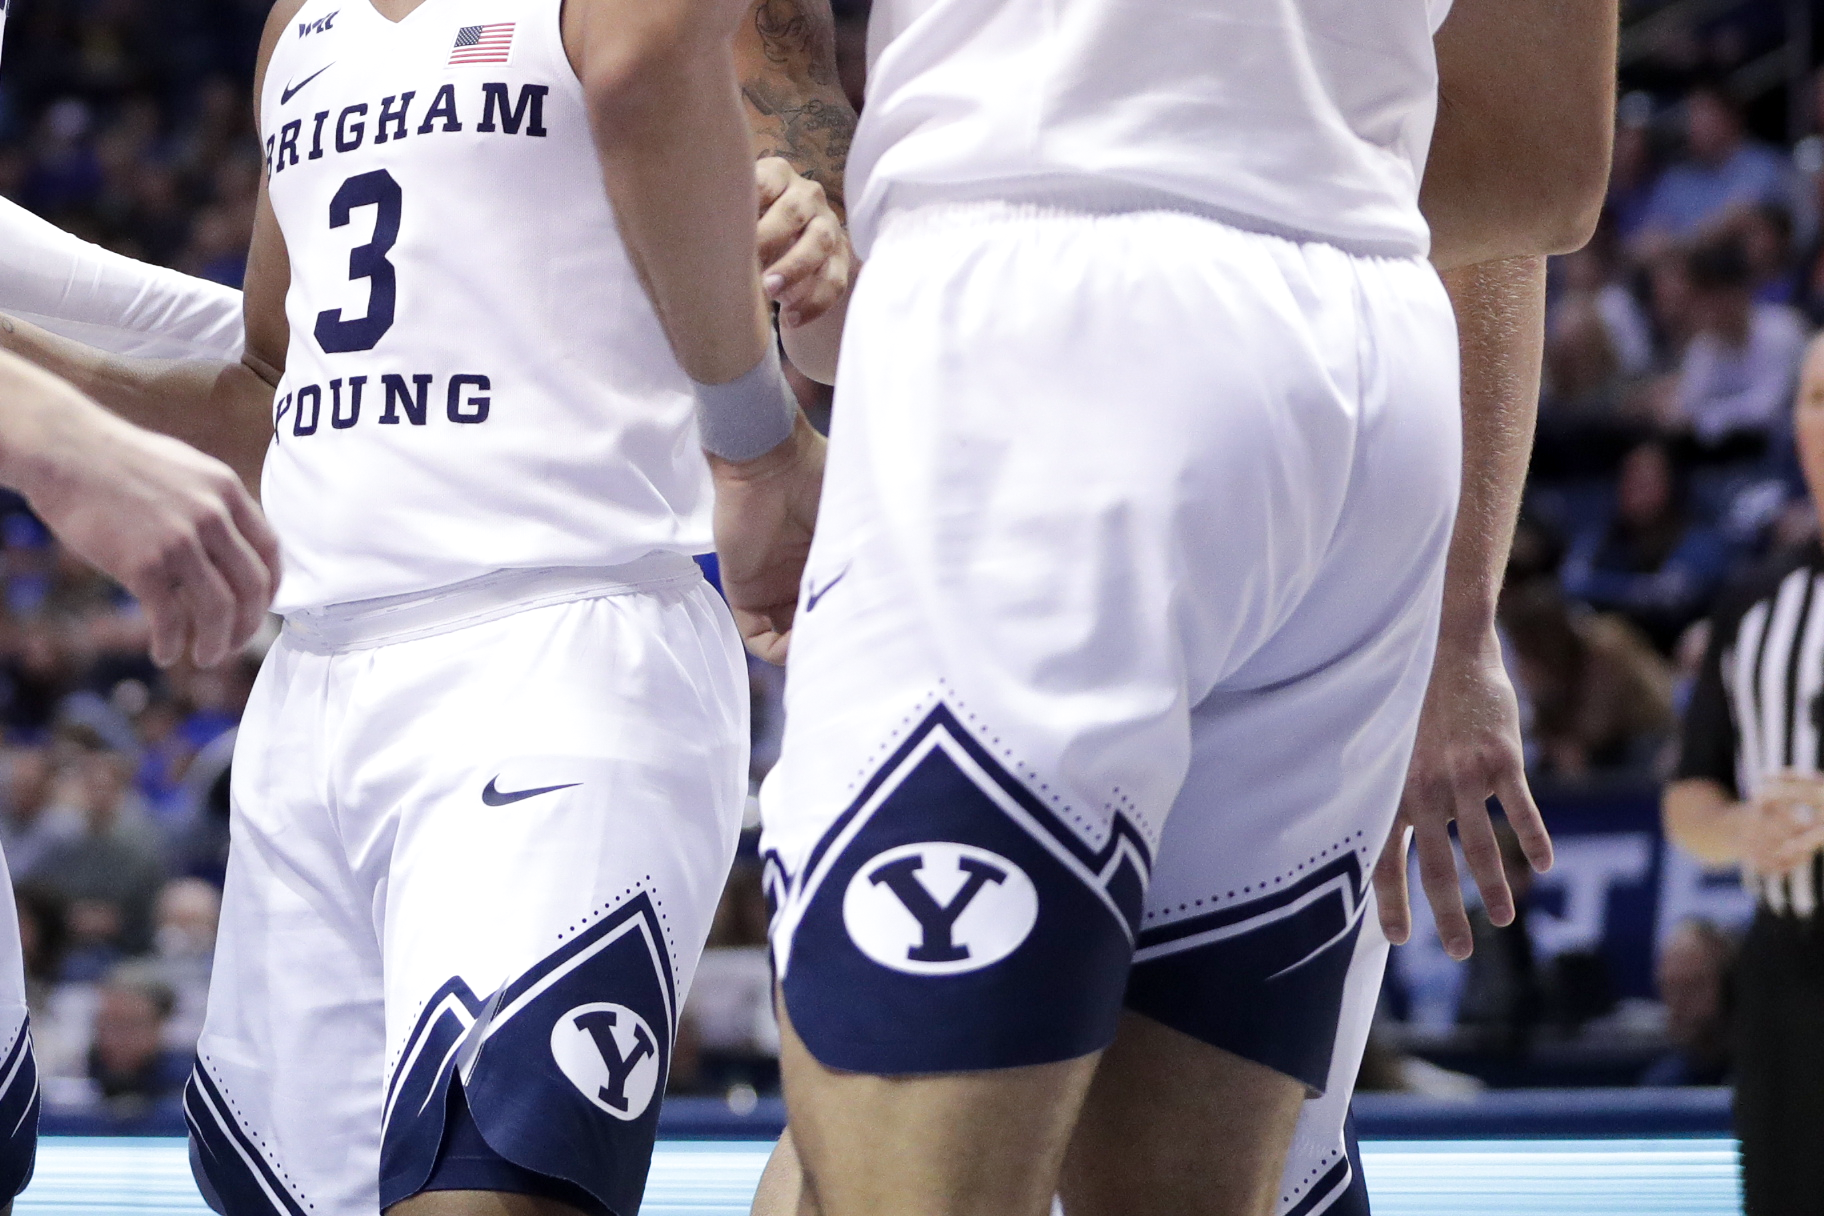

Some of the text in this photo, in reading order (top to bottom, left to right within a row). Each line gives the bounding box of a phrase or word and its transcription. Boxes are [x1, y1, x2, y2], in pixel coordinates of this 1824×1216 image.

[313, 168, 403, 355] 3
[868, 853, 1007, 962] Y
[573, 1011, 655, 1112] Y
